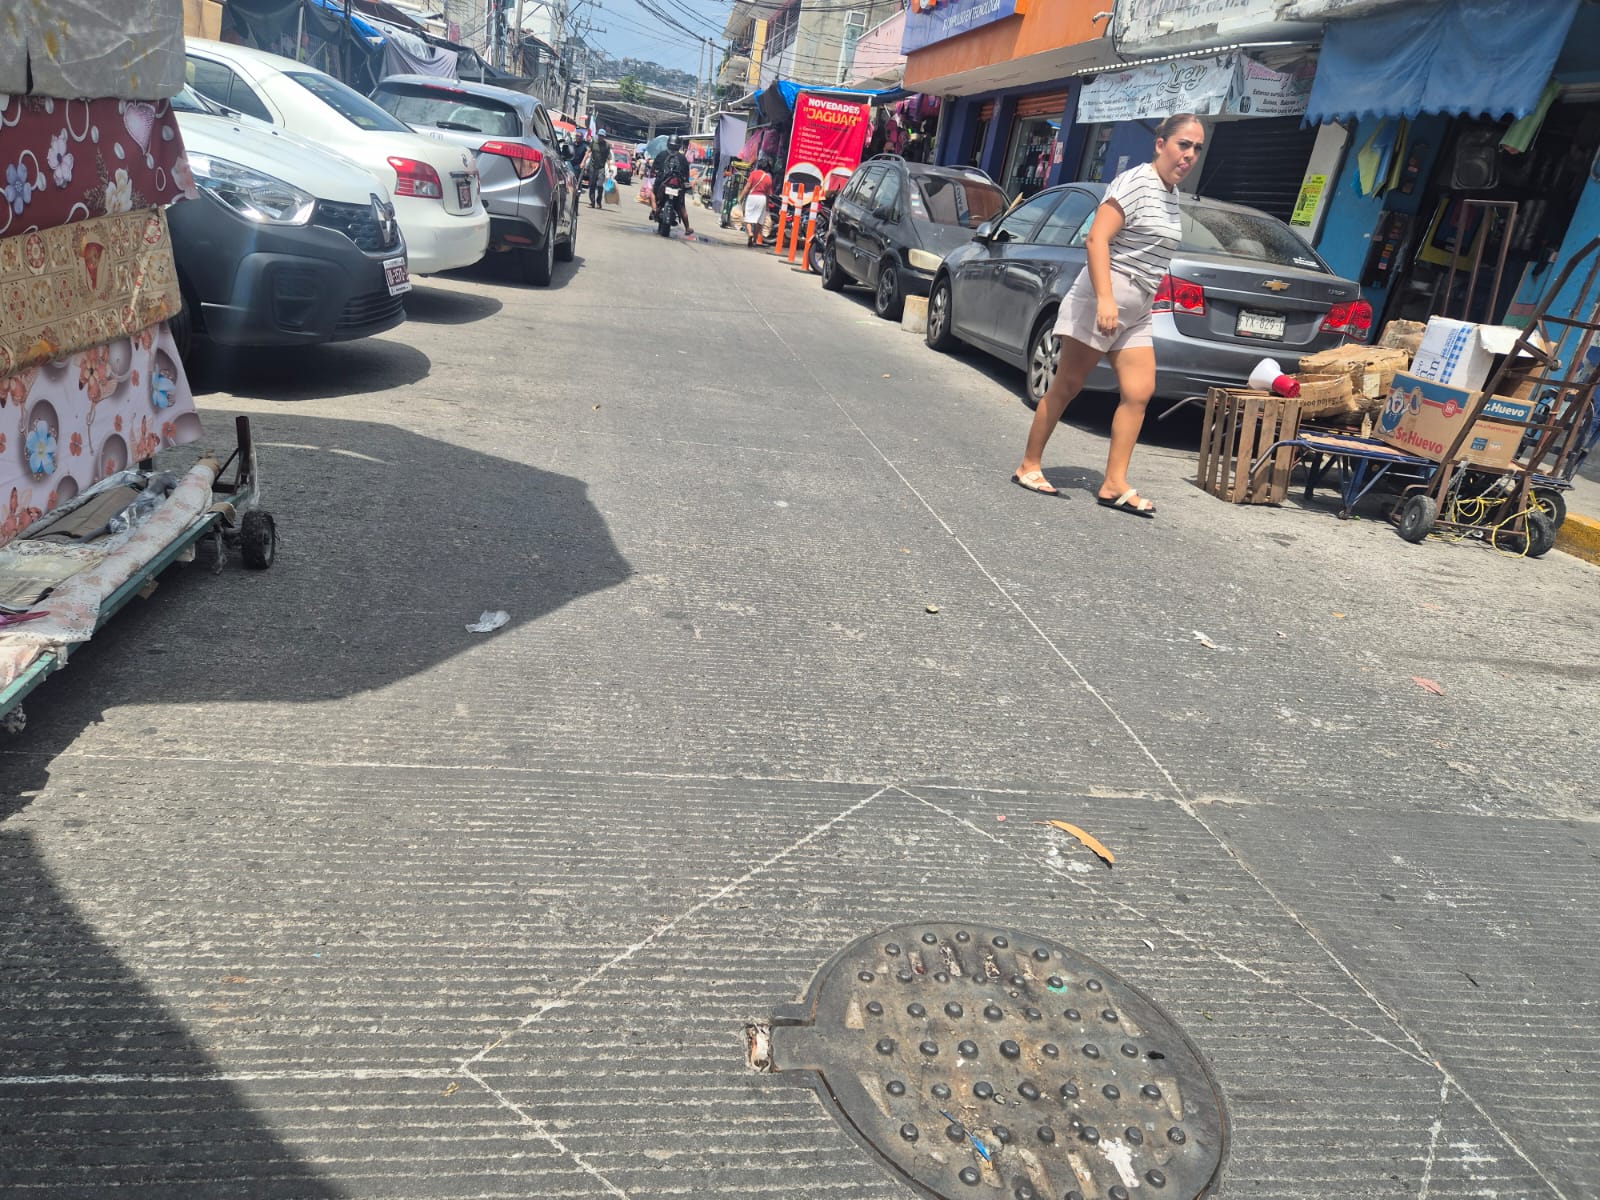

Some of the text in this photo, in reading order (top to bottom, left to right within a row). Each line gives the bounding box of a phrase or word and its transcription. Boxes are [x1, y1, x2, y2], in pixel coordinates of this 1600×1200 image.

[808, 98, 860, 115] NOVEDADES
[803, 106, 862, 127] "JAGUAR"
[1484, 401, 1524, 417] r.Huevo
[1395, 427, 1443, 454] Sr.Huevo
